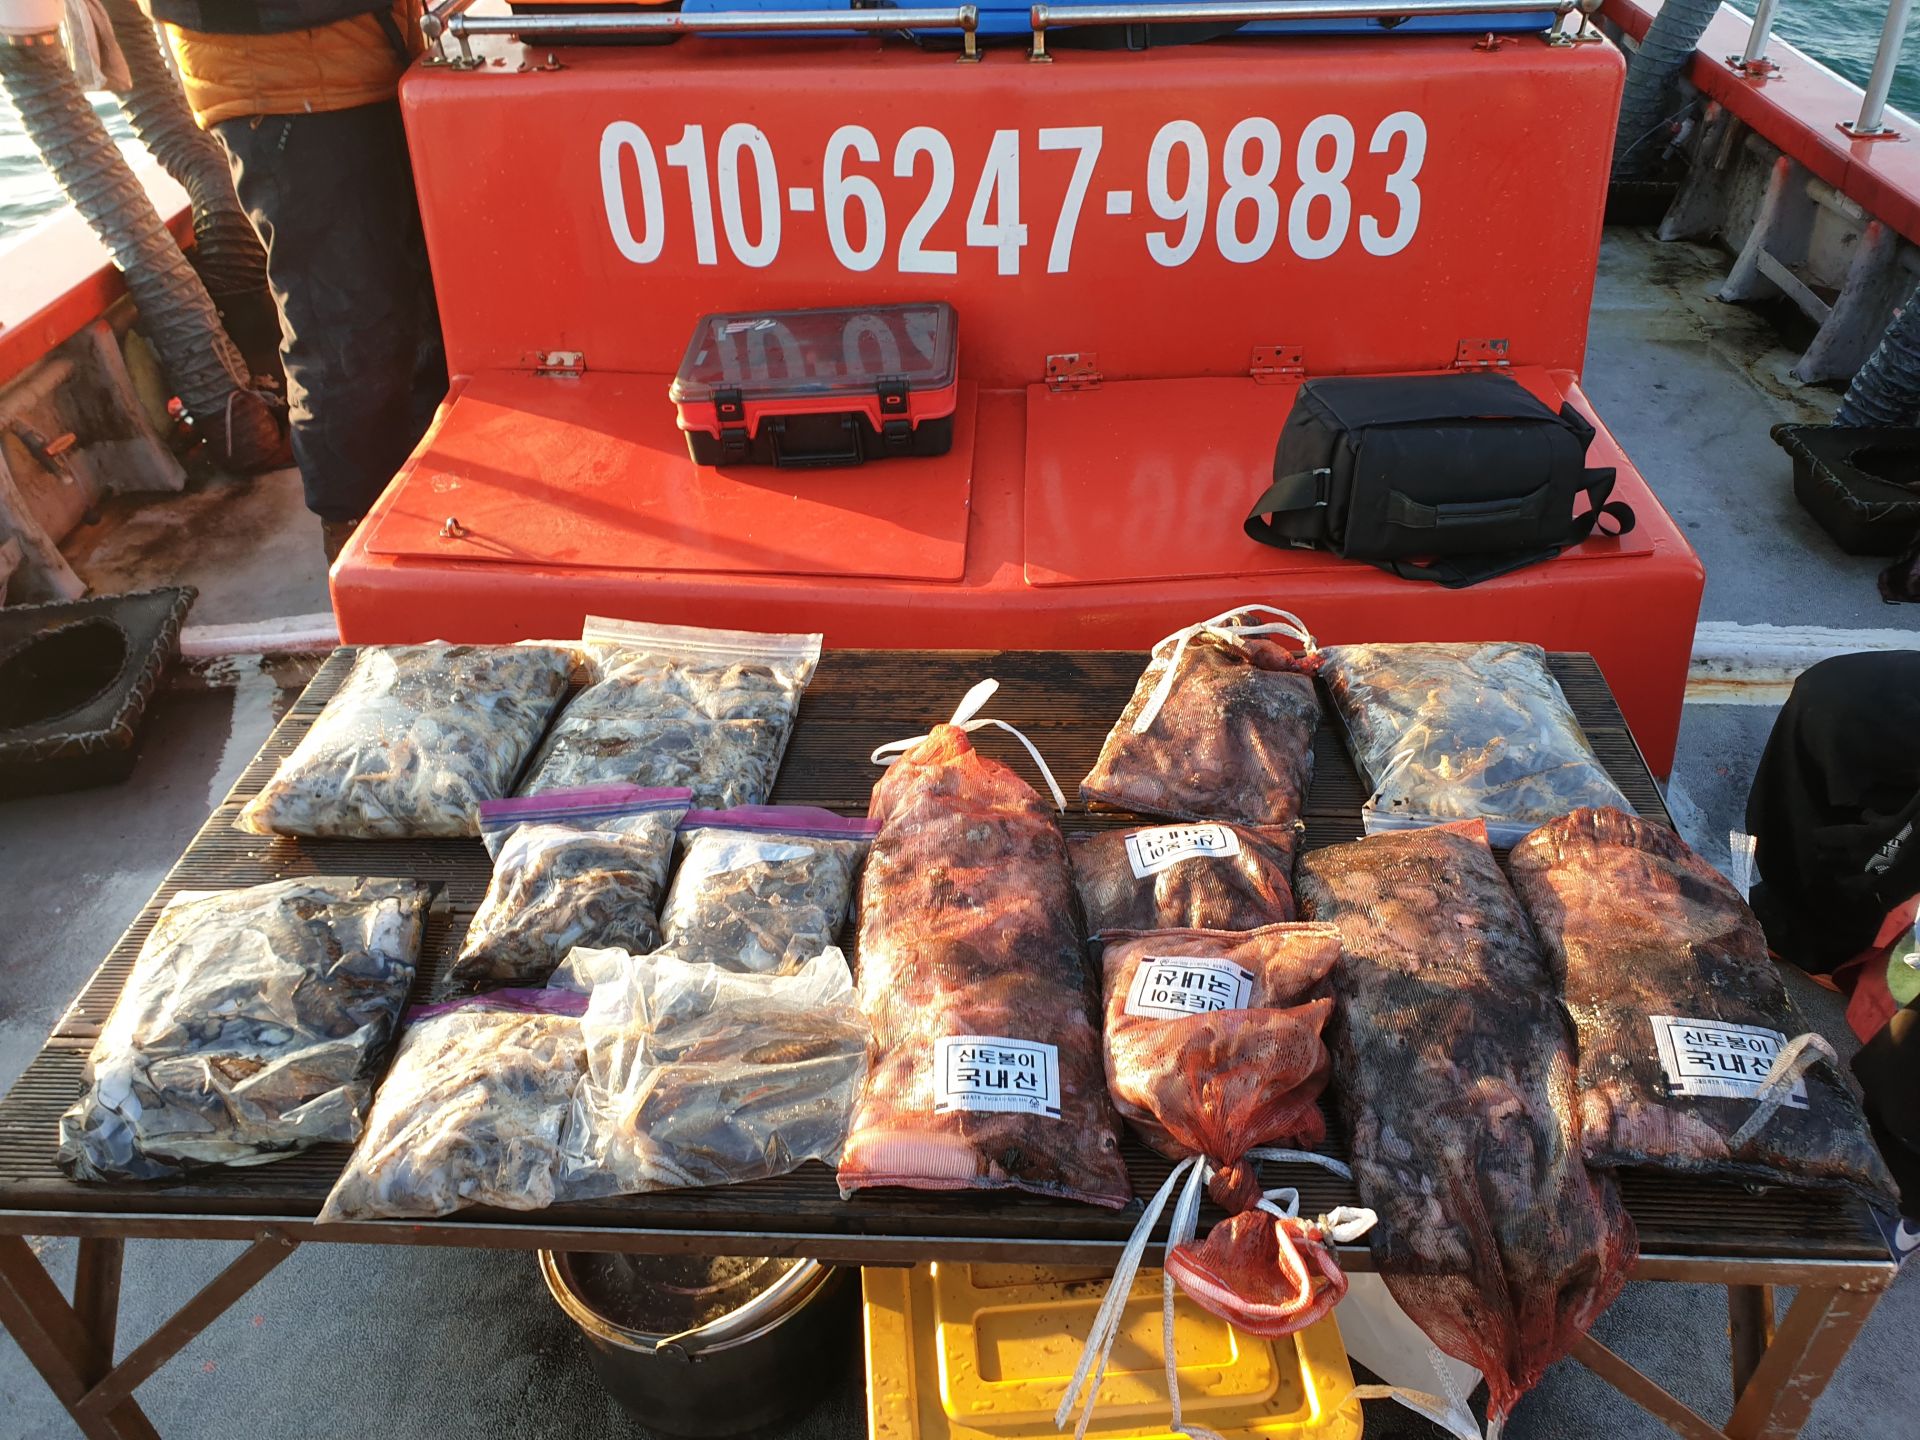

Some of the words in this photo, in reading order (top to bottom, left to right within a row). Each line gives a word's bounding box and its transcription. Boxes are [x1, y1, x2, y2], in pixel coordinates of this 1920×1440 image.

[599, 111, 1428, 276] 010-6247-9883
[1154, 969, 1231, 998] 국내산
[1683, 1031, 1769, 1054] 신토불이
[958, 1048, 1035, 1069] 신토불이
[956, 1068, 1038, 1092] 국내산
